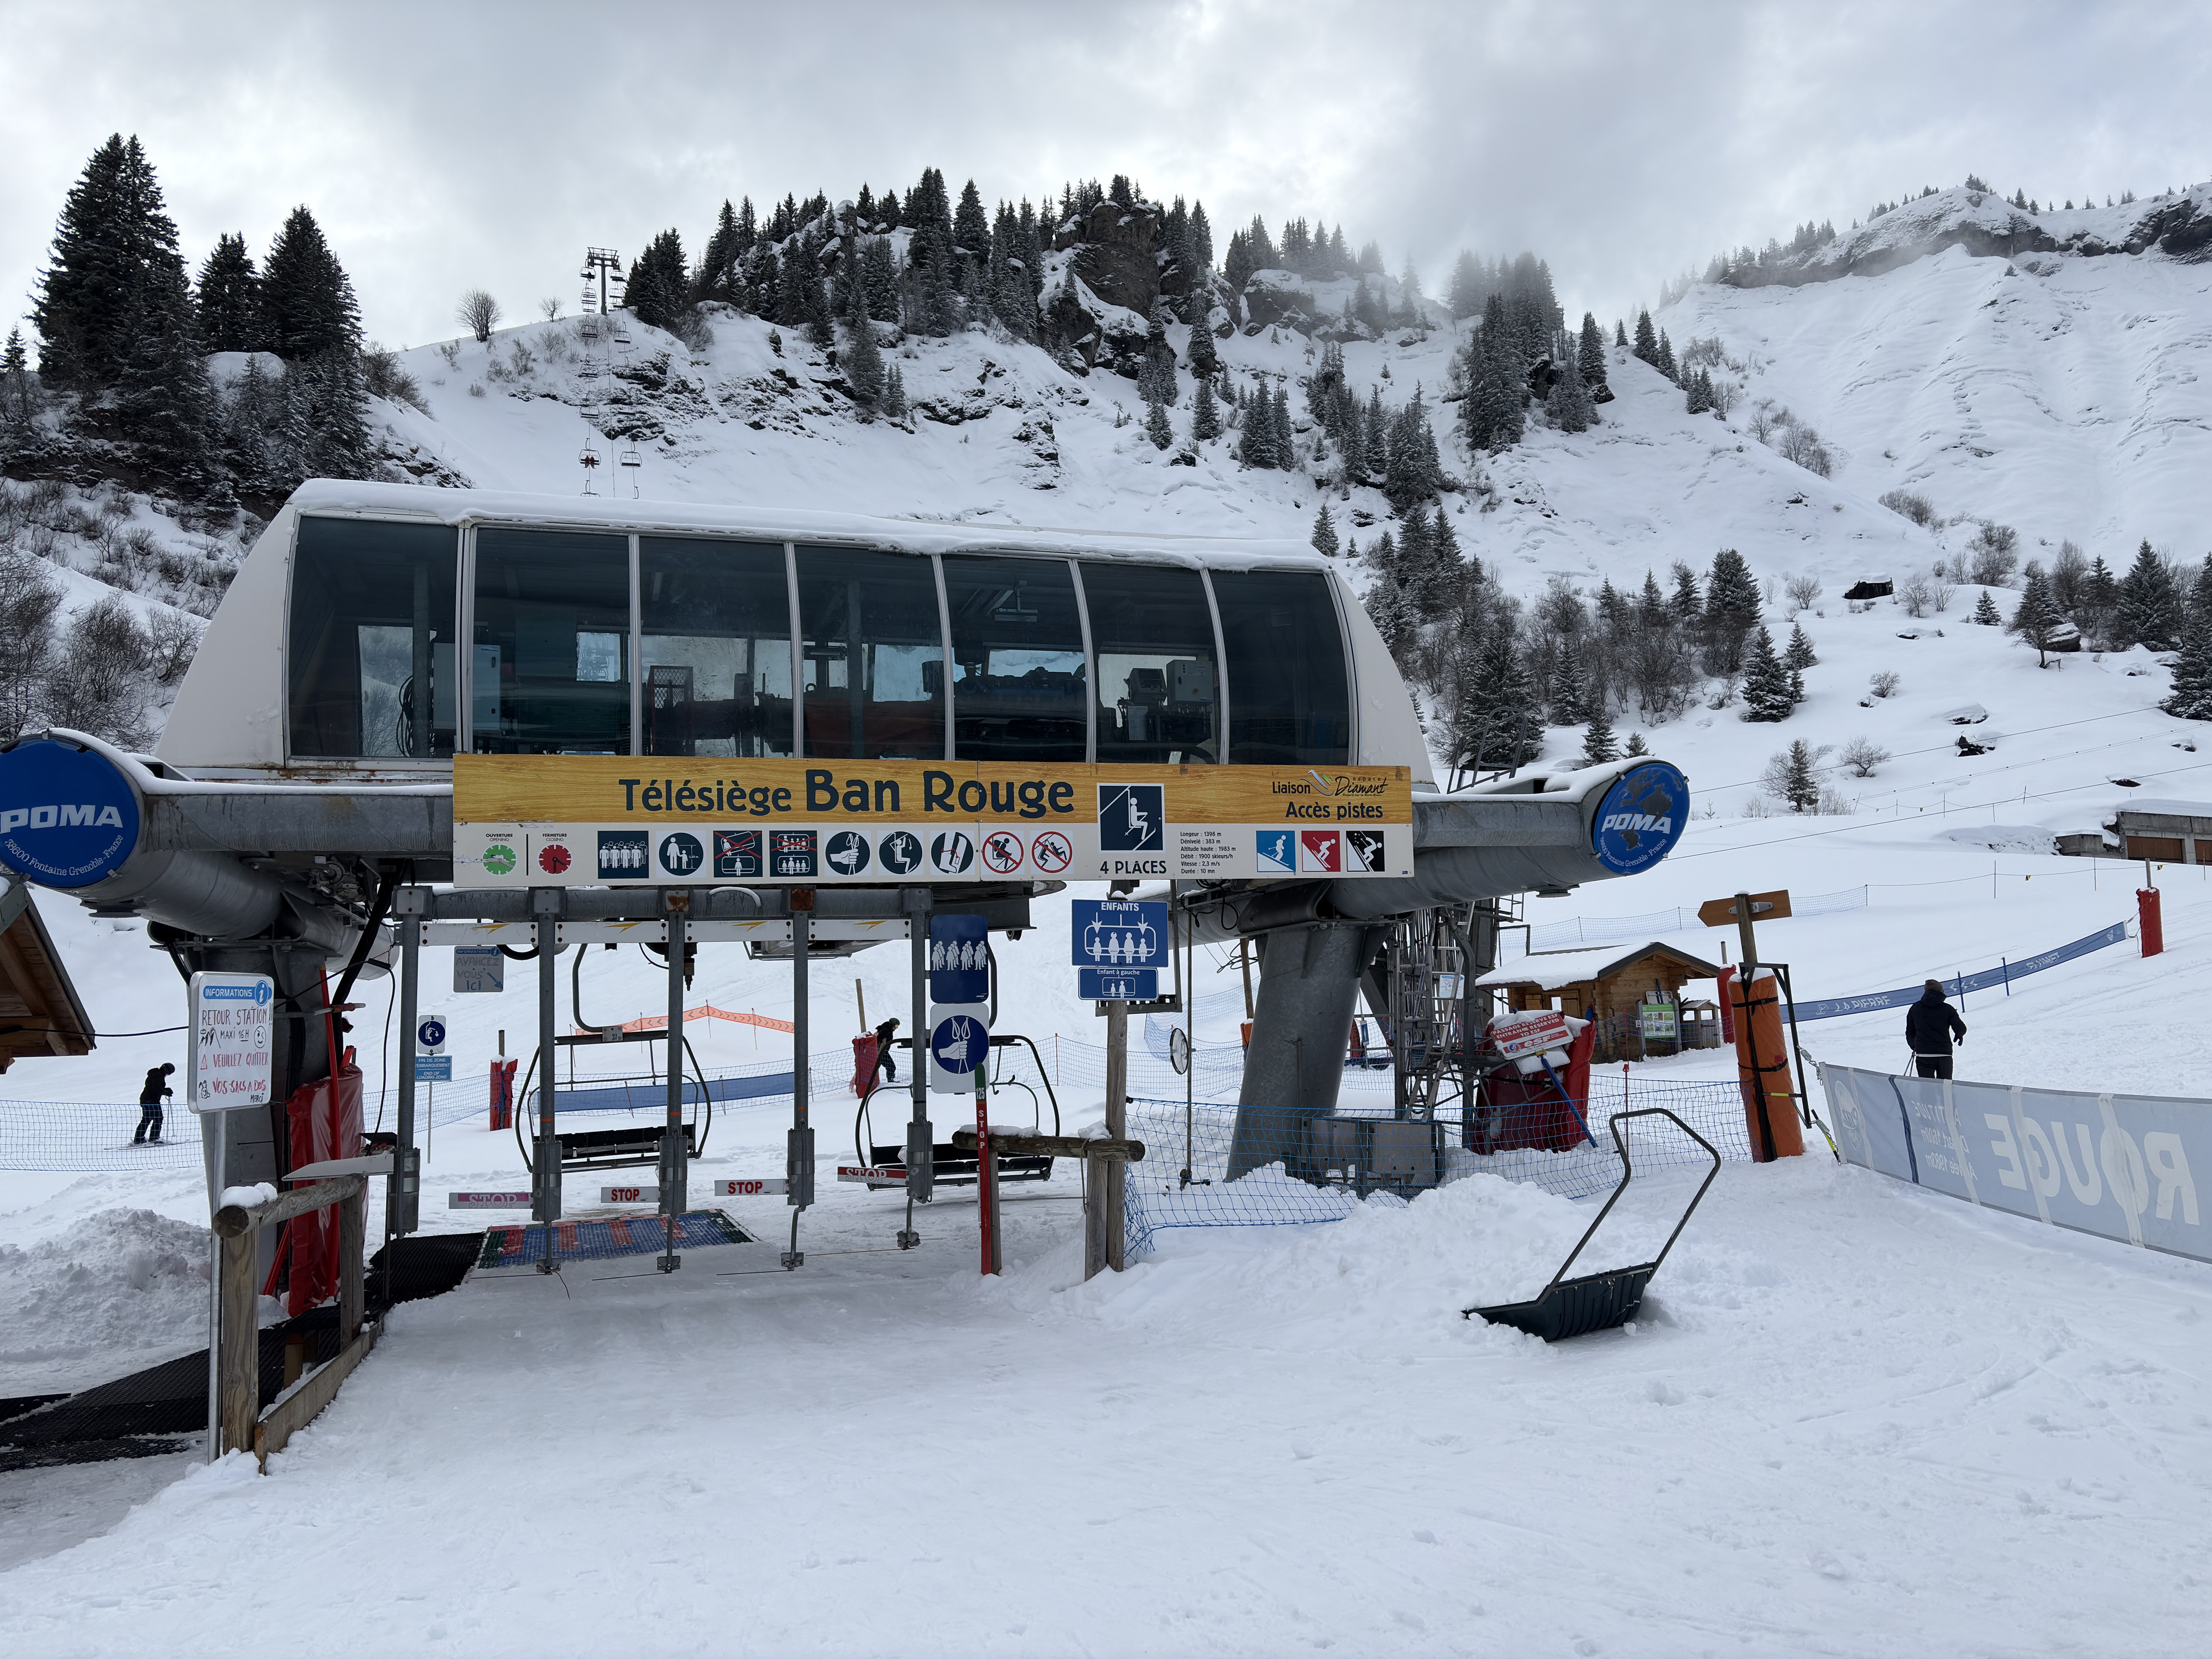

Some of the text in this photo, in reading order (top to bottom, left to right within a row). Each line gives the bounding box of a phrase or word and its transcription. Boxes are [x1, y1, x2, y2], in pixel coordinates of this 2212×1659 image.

[1272, 781, 1311, 794] Liaison
[1335, 776, 1389, 796] Diamant
[618, 769, 1074, 819] Télésiège Ban Rouge
[1285, 801, 1383, 820] Accès pistes
[0, 805, 123, 834] POMA
[1601, 813, 1671, 834] POMA
[4, 839, 30, 862] 38600
[28, 857, 67, 876] Fontaine
[1606, 851, 1625, 867] Fontaine
[1100, 860, 1167, 874] 4 PLACES
[1101, 902, 1139, 911] ENFANTS
[456, 957, 499, 966] AVANCEZ
[456, 970, 483, 979] VOUS
[205, 988, 253, 997] INFORMATIONS
[1835, 995, 1891, 1012] LA PIERRE
[202, 1009, 231, 1026] RETOUR
[1530, 1018, 1559, 1029] RESERVED
[1493, 1024, 1521, 1035] PASSAGE
[213, 1052, 268, 1068] VEUILLEZ QUITTER
[212, 1077, 228, 1094] VOS
[230, 1080, 246, 1093] SACS
[976, 1087, 985, 1099] 125
[846, 1168, 887, 1183] STOP
[611, 1188, 640, 1201] STOP
[728, 1181, 763, 1194] STOP
[469, 1193, 517, 1208] STOP
